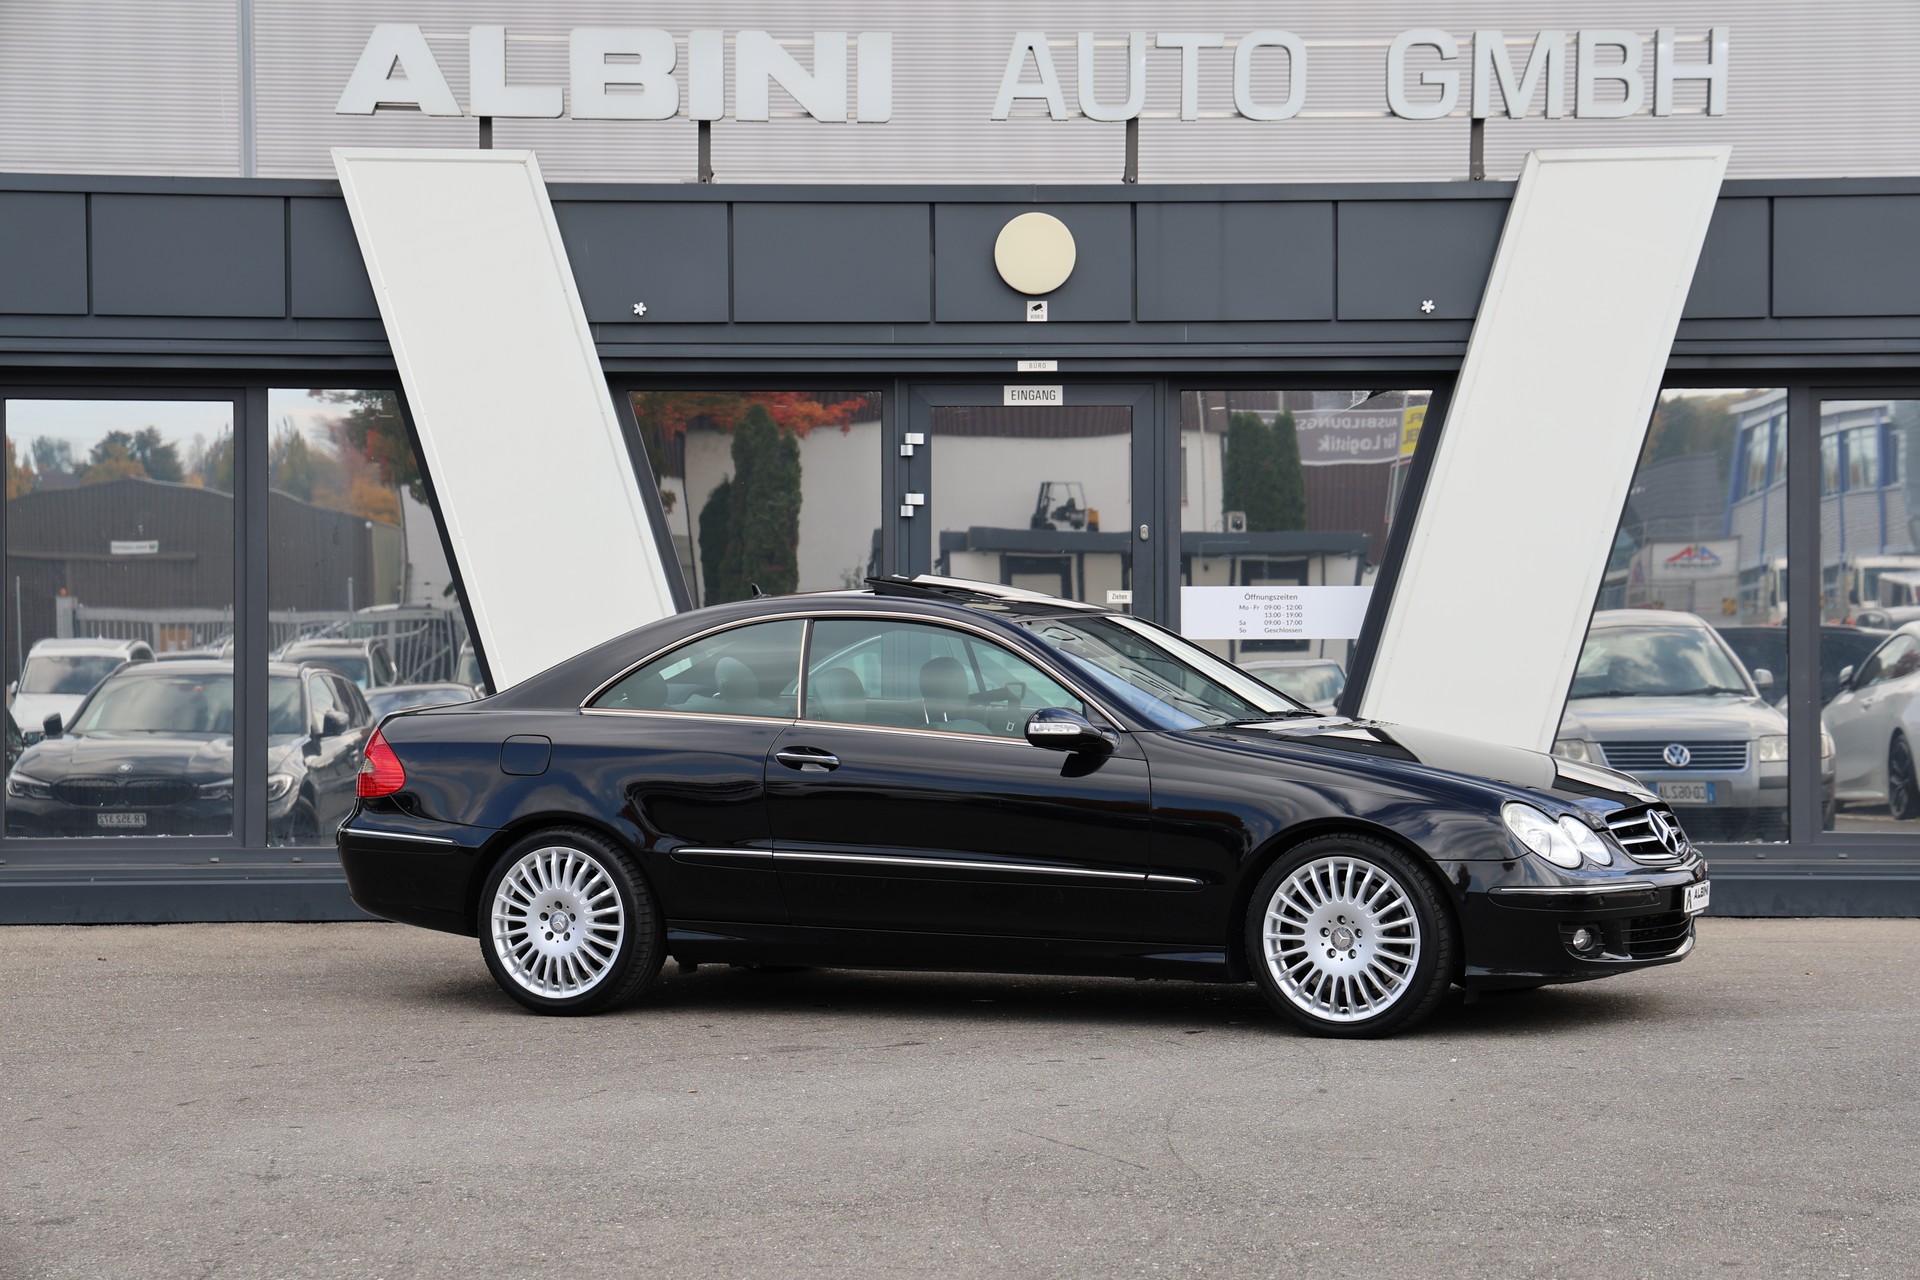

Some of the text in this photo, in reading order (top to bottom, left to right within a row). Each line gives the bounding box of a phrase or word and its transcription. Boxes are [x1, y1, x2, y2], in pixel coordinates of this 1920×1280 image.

[335, 23, 1730, 123] ALBINI AUTO GMBH
[1028, 361, 1047, 369] BÜRO
[1011, 390, 1056, 401] EINGANG
[1244, 592, 1298, 601] Öffnungszeiten
